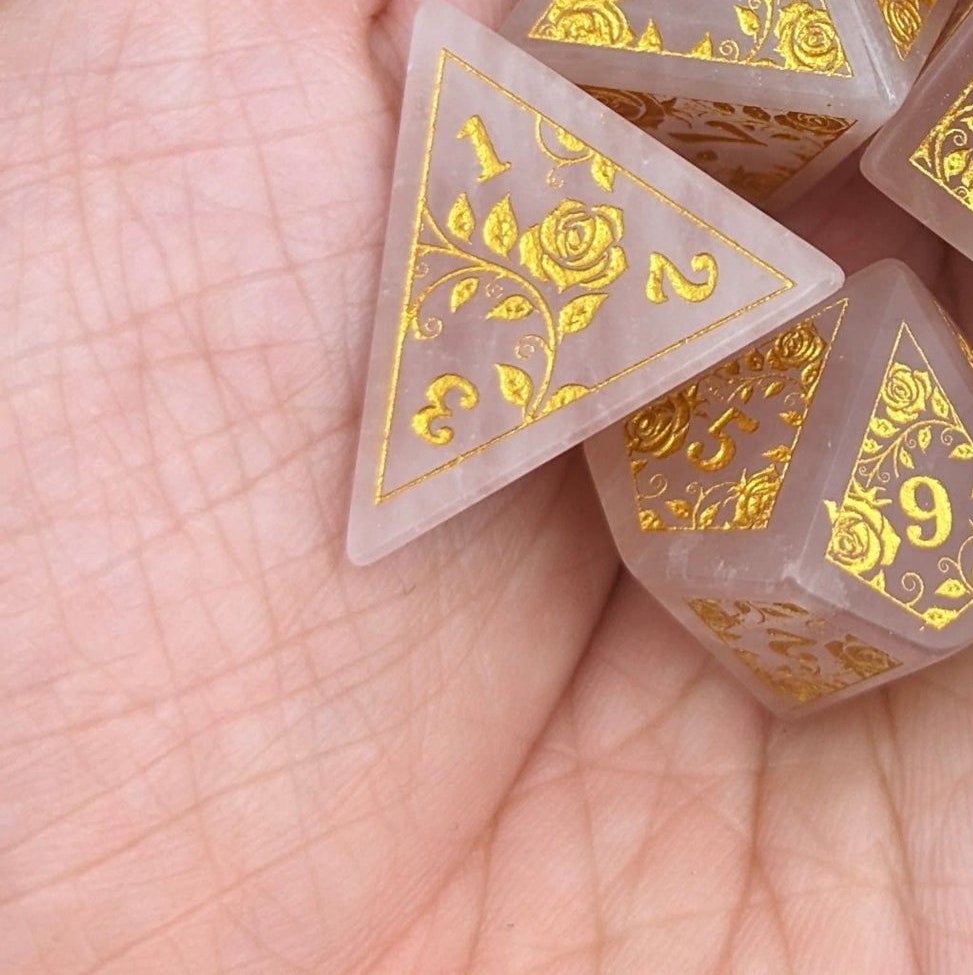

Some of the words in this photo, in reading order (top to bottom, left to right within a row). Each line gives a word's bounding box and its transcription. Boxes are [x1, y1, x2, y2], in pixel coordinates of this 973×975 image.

[456, 115, 512, 182] 1
[646, 252, 718, 305] 2
[411, 373, 480, 446] 3
[687, 407, 760, 472] 5
[900, 475, 954, 549] 9
